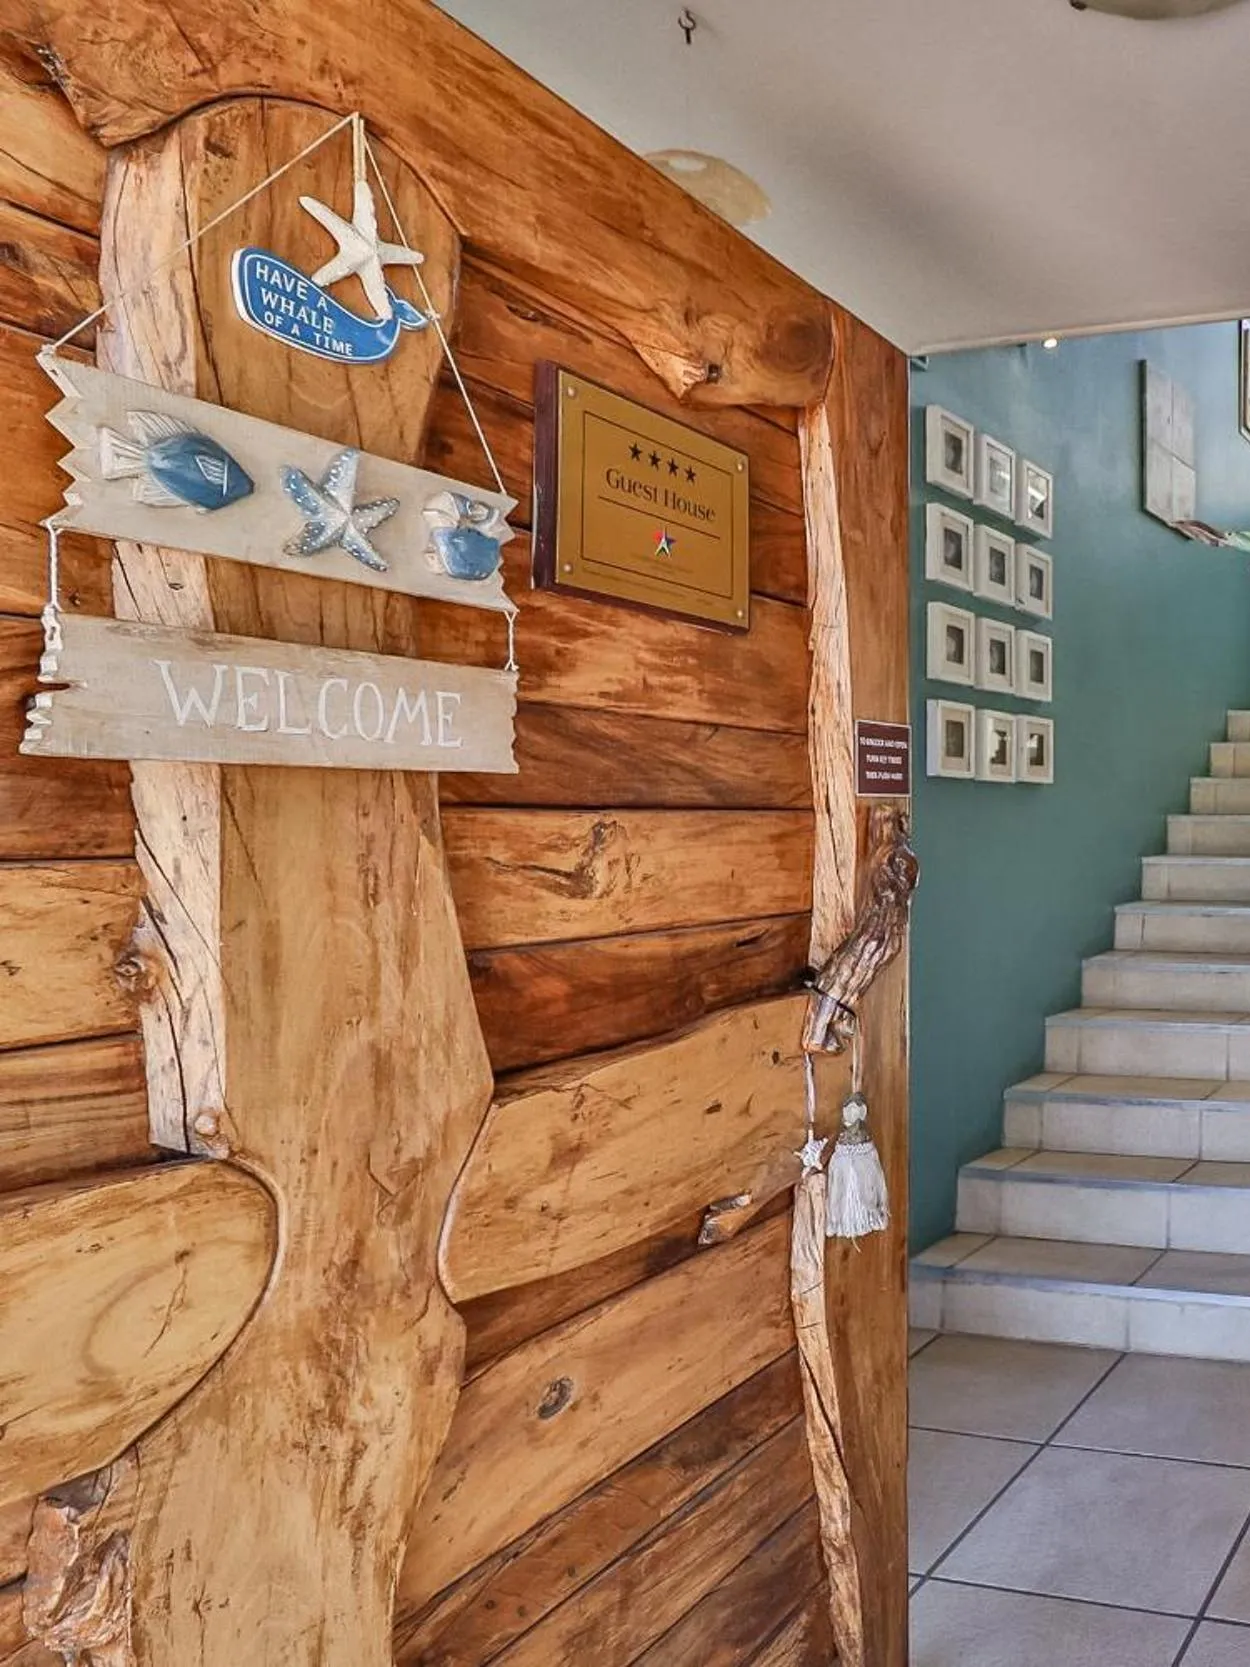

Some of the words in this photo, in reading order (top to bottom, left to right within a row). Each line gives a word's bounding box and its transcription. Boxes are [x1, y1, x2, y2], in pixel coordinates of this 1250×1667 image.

[256, 262, 308, 300] HAVE
[318, 297, 328, 311] A
[260, 288, 335, 334] WHALE
[264, 311, 284, 328] OF
[291, 325, 300, 335] A
[313, 333, 353, 355] TIME
[605, 467, 658, 504] Guest
[664, 488, 716, 522] House
[152, 659, 465, 748] WELCOME
